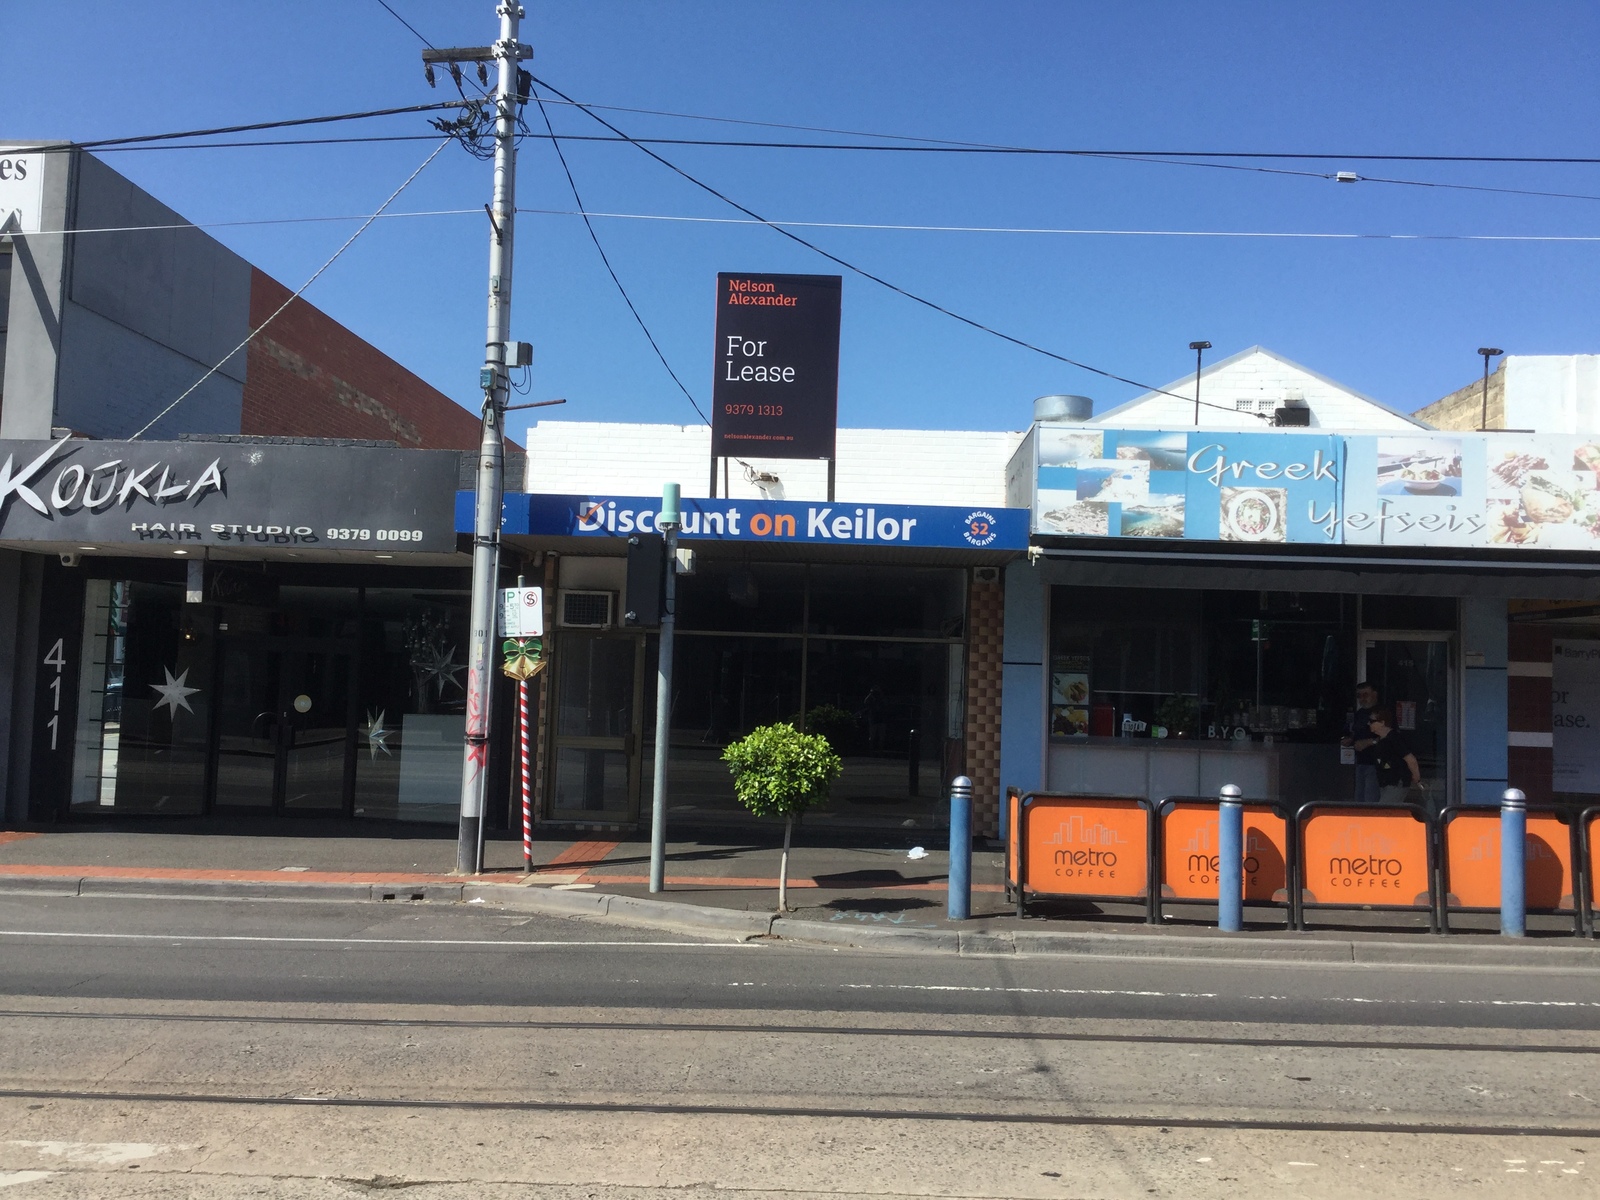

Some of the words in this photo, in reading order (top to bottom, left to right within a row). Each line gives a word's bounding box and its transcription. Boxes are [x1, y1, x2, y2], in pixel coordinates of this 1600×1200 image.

[728, 279, 775, 293] Nelson
[728, 293, 798, 307] Alexander
[726, 335, 768, 357] For
[725, 360, 796, 383] Lease
[725, 404, 754, 416] 9379
[758, 405, 783, 416] 1313
[1187, 444, 1338, 487] Greek
[750, 512, 796, 537] on
[807, 507, 917, 541] Keilor
[964, 510, 996, 525] BARGAINS
[131, 522, 196, 532] HAIR
[210, 523, 313, 536] STUDIO
[326, 528, 371, 541] 9379
[376, 529, 424, 542] 0099
[971, 521, 989, 536] $2
[963, 531, 997, 546] BARGAINS
[1564, 648, 1600, 661] BarryP
[1054, 848, 1117, 867] metro
[1188, 853, 1260, 873] meo
[1330, 854, 1403, 876] metro
[1055, 868, 1116, 879] COFFEE
[1189, 874, 1258, 886] COFE
[1331, 877, 1401, 888] COFFEE
